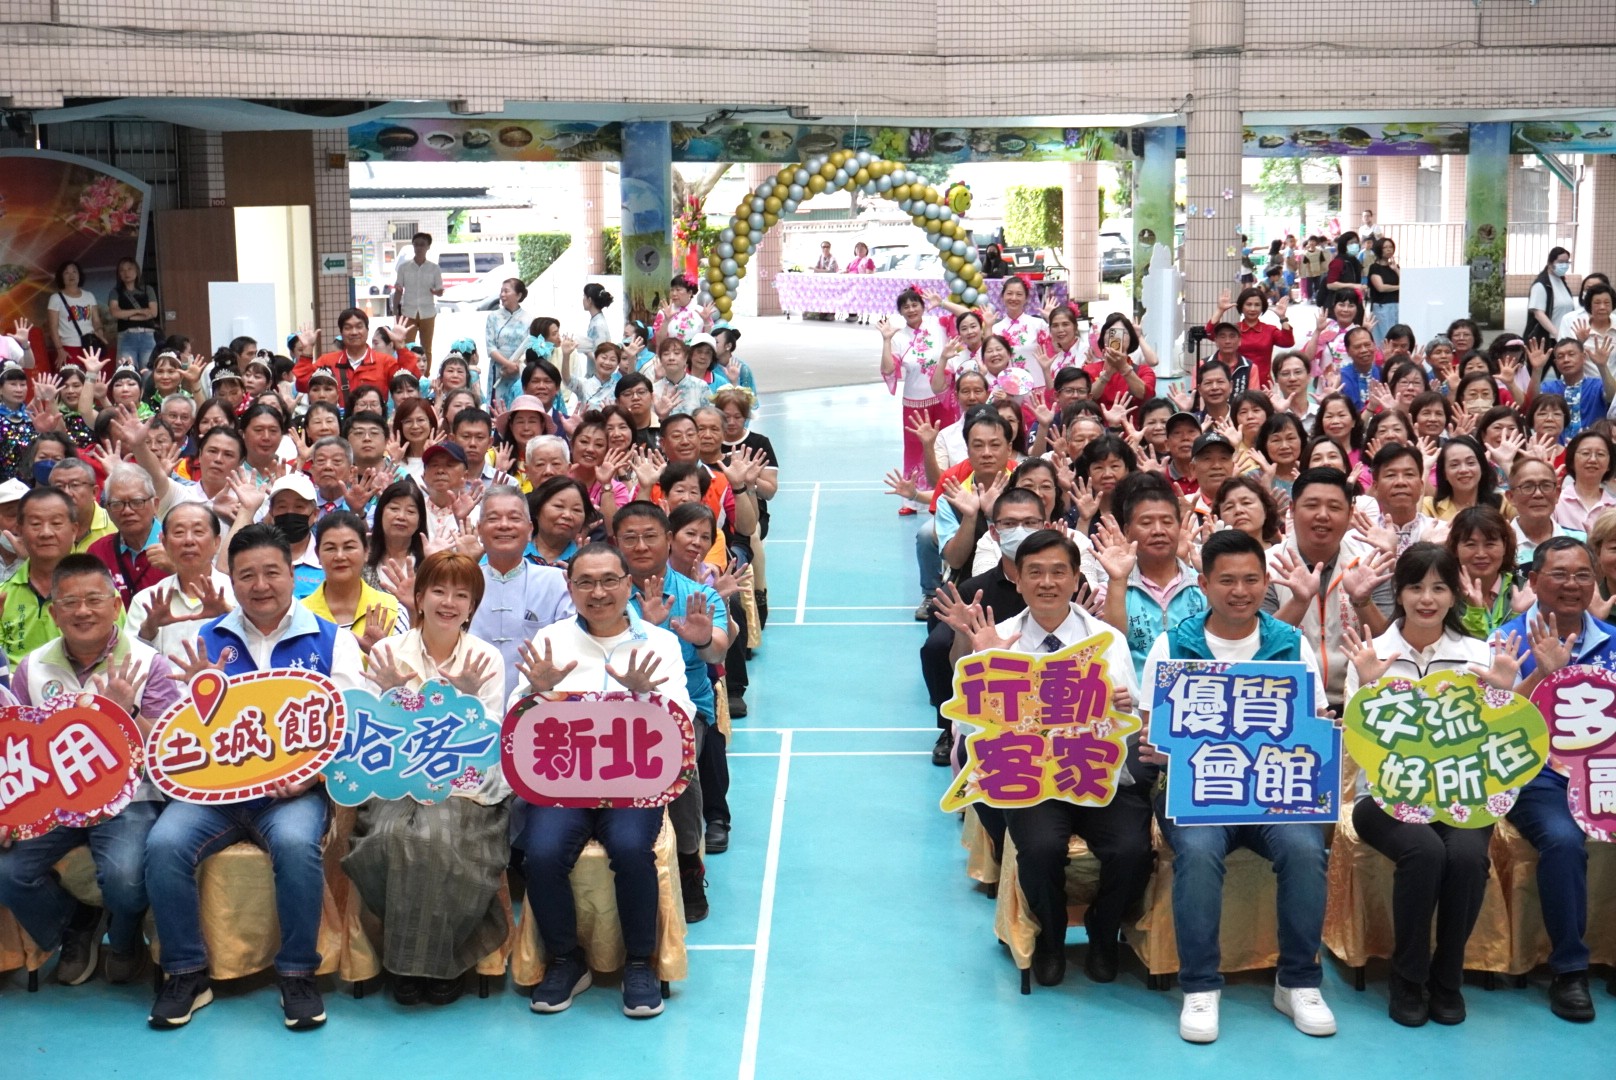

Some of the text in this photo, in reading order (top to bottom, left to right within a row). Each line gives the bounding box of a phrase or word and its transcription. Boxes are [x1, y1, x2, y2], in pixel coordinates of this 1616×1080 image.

[961, 657, 1107, 725] 行動
[1168, 673, 1292, 737] 優質
[1363, 688, 1483, 745] 交流
[161, 695, 328, 767] 土城館
[333, 711, 496, 780] 哈客
[533, 717, 663, 781] 新北
[973, 730, 1120, 800] 客家
[1191, 743, 1315, 804] 會館
[1380, 730, 1535, 803] 好所在
